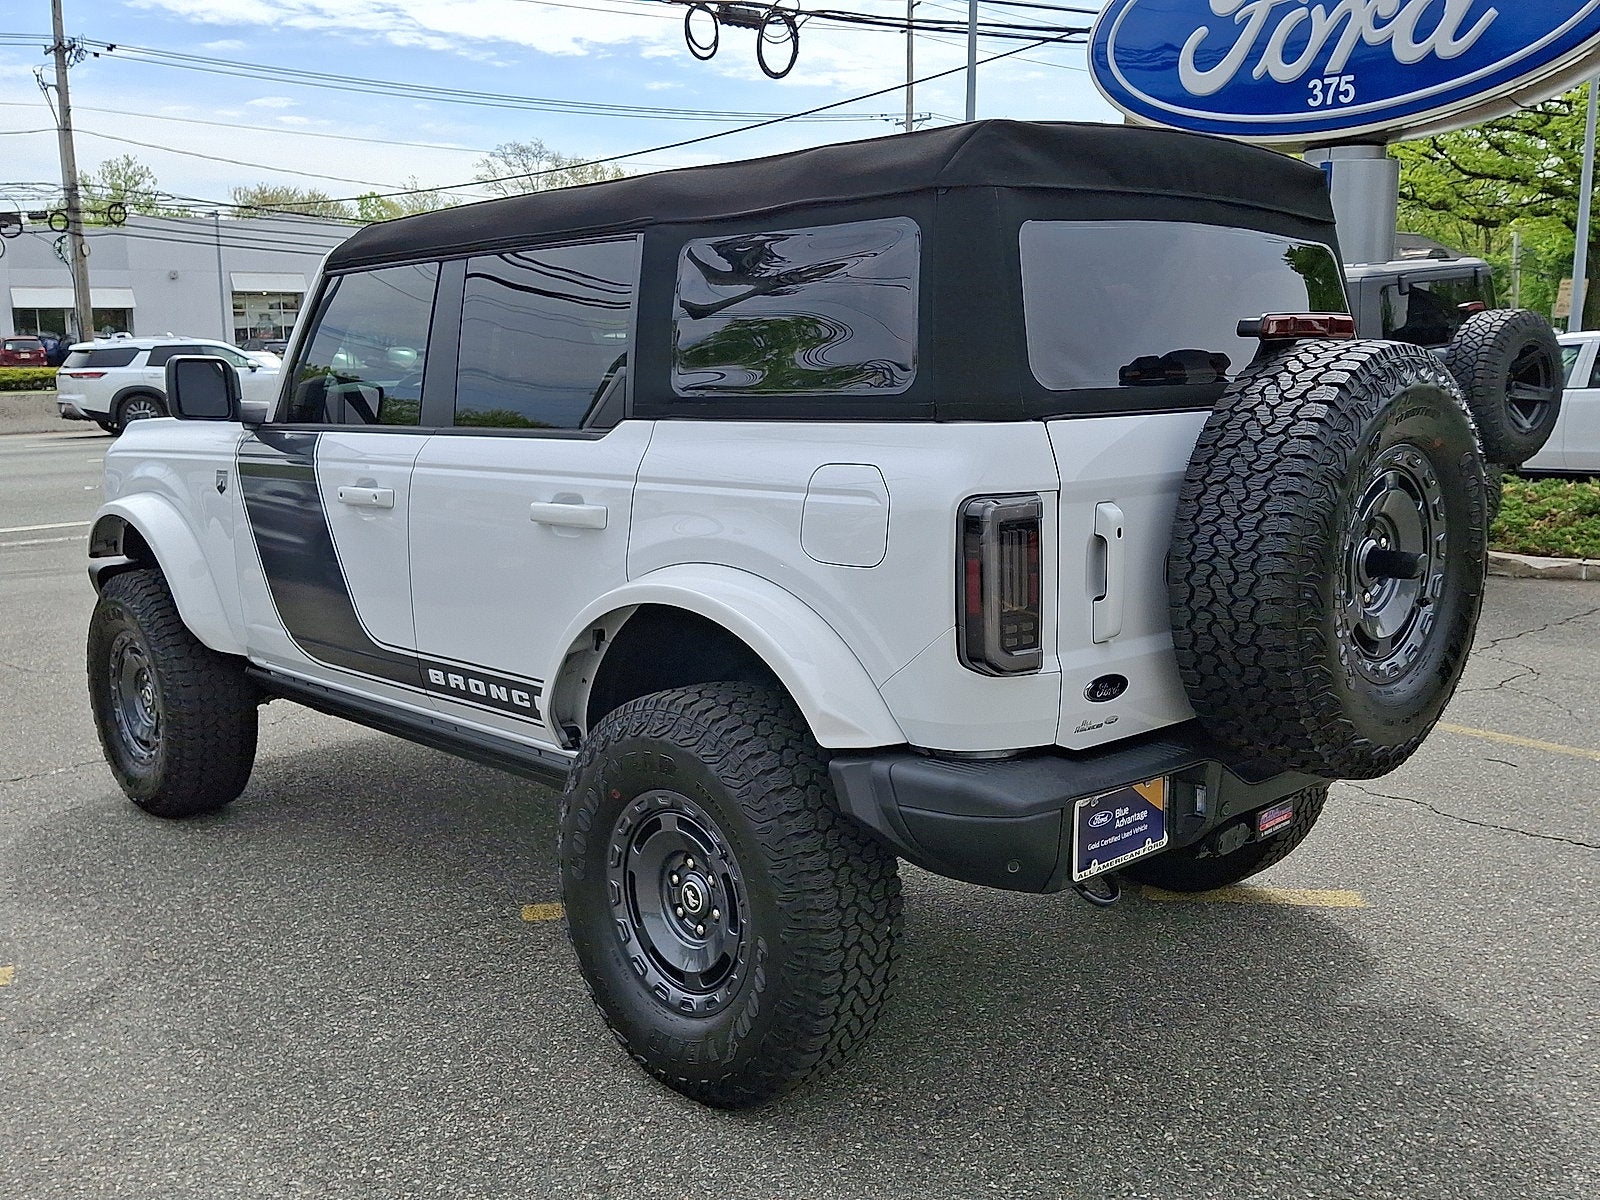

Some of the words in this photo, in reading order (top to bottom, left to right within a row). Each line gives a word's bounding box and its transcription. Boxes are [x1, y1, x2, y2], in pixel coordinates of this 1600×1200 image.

[1178, 0, 1499, 96] Ford
[1307, 75, 1356, 107] 375
[1096, 682, 1121, 698] Ford
[1114, 810, 1148, 829] Advantage
[1115, 807, 1130, 818] Blue
[1087, 840, 1101, 851] Gold
[1100, 833, 1121, 846] Certified
[1121, 829, 1133, 840] Used
[1132, 823, 1148, 835] Vehicle
[1077, 869, 1093, 880] ALL
[1096, 849, 1141, 872] AMERICAN
[1142, 840, 1165, 854] FORD
